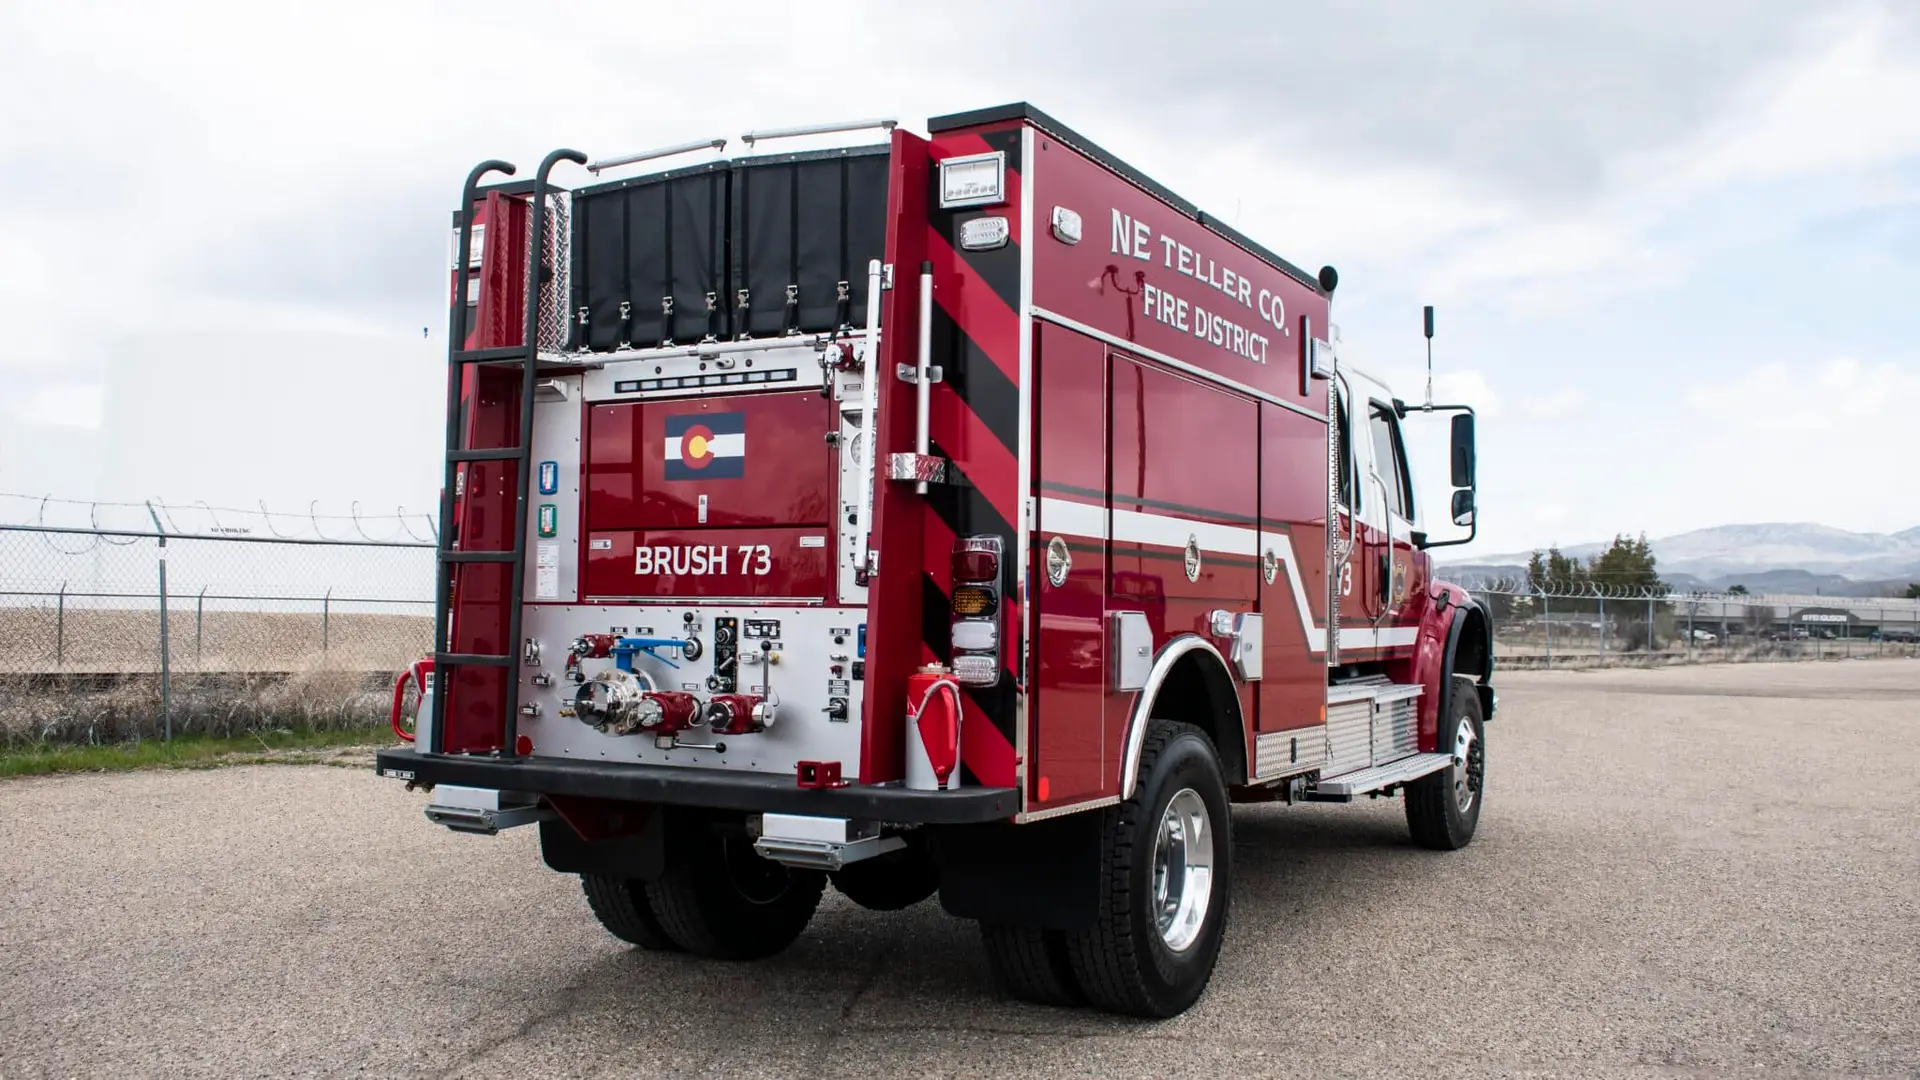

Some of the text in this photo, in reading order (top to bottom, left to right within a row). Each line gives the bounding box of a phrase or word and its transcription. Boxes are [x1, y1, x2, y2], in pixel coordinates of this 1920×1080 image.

[1111, 208, 1289, 337] NE TELLER CO.
[1144, 283, 1269, 364] FIRE DISTRICT
[634, 544, 772, 576] BRUSH 73
